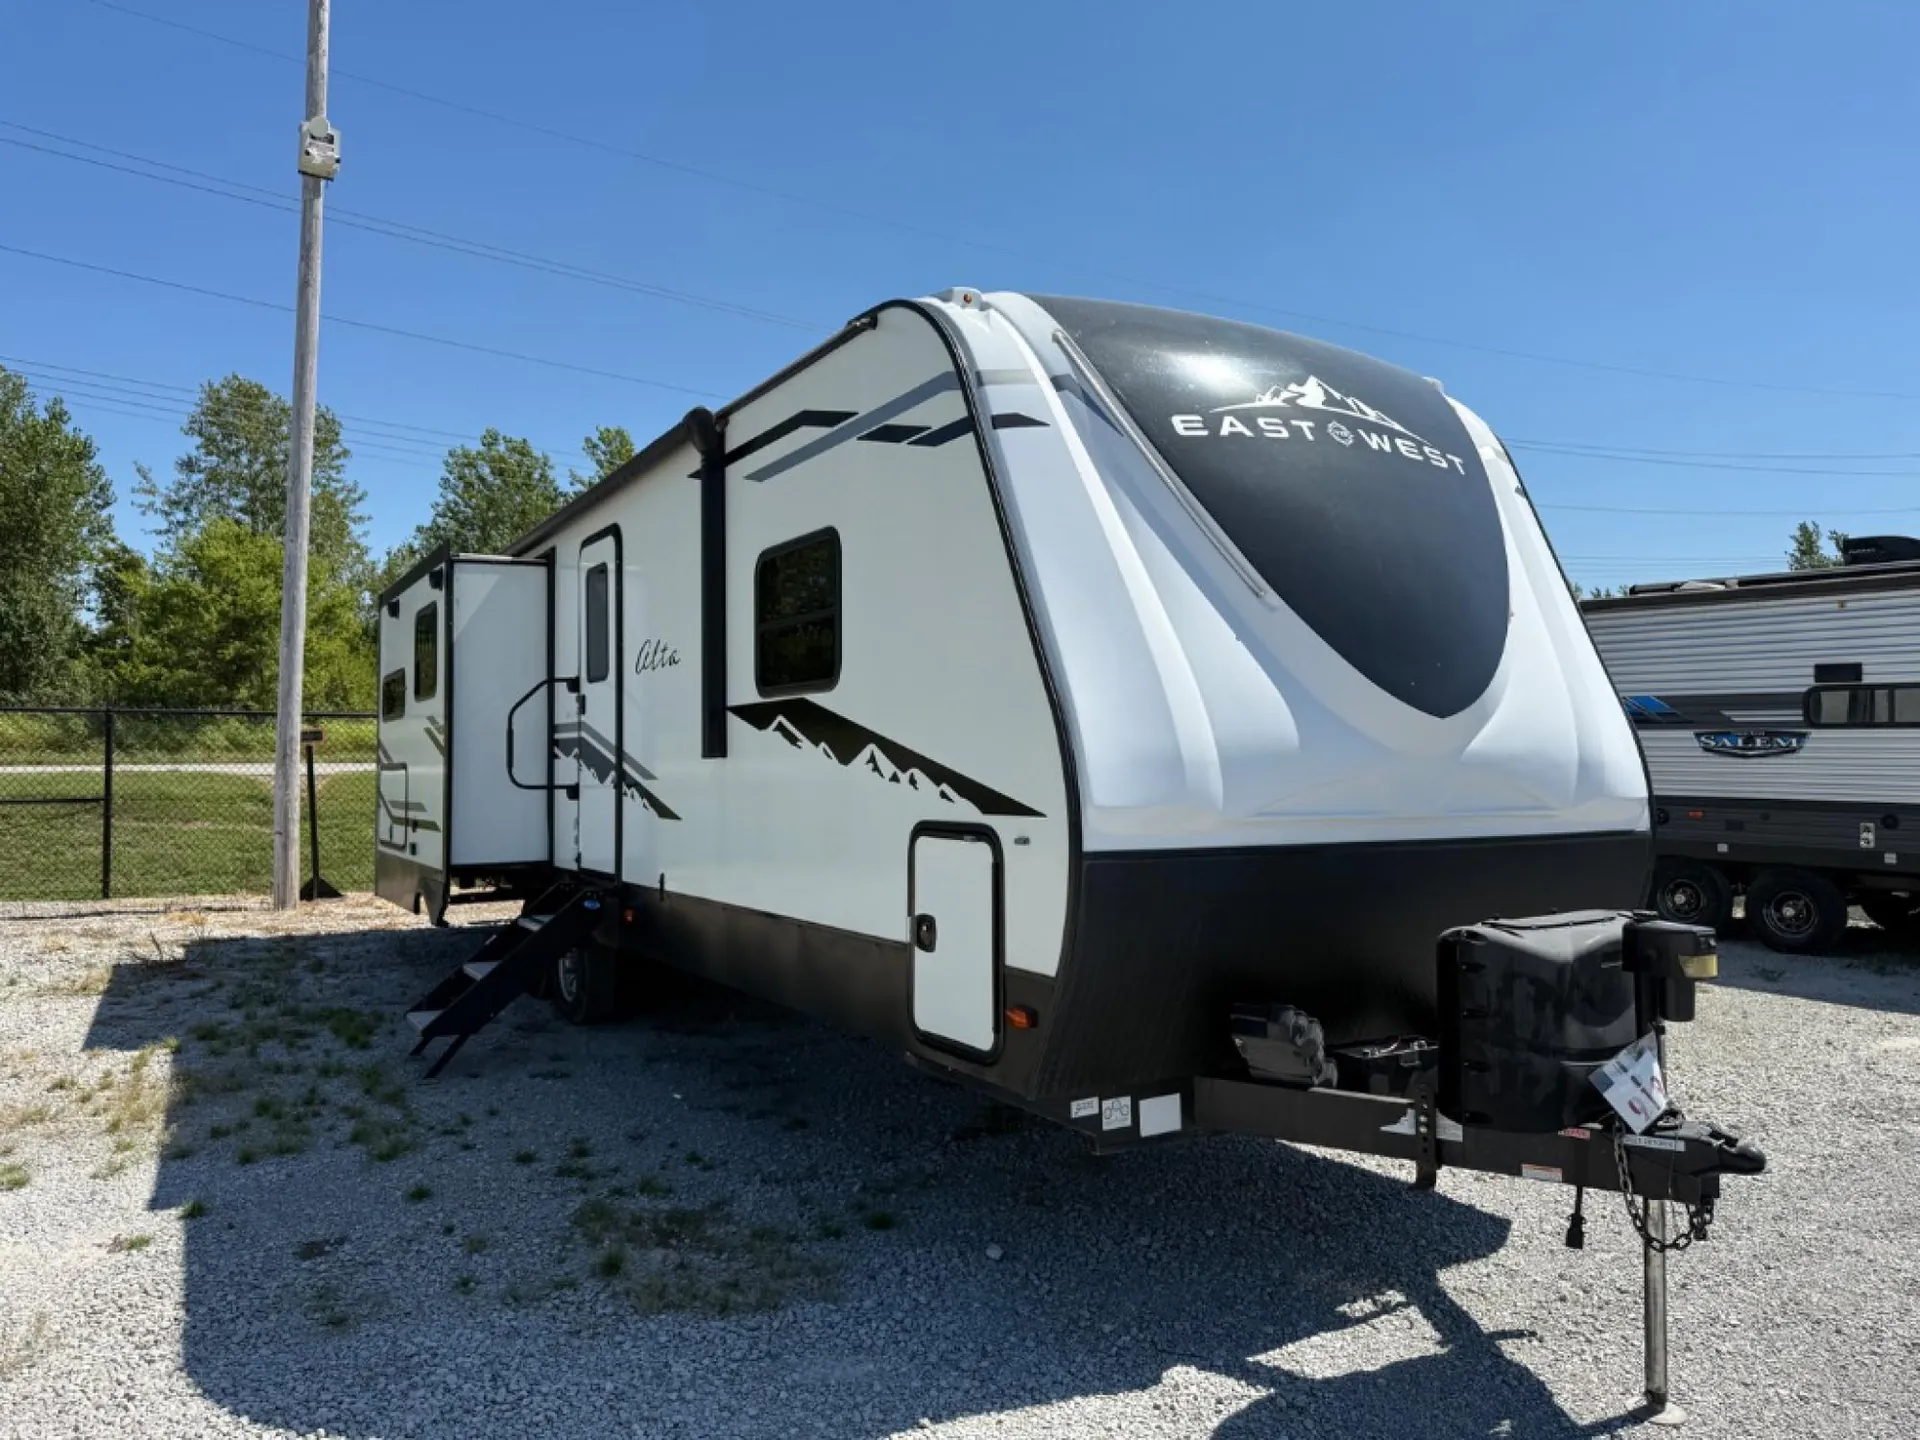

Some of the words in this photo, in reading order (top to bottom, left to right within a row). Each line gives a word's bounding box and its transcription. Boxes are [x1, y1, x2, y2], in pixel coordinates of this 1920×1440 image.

[1171, 414, 1315, 441] EAST
[1358, 428, 1466, 475] WEST
[635, 638, 681, 675] Alta
[1700, 734, 1798, 748] SALEM
